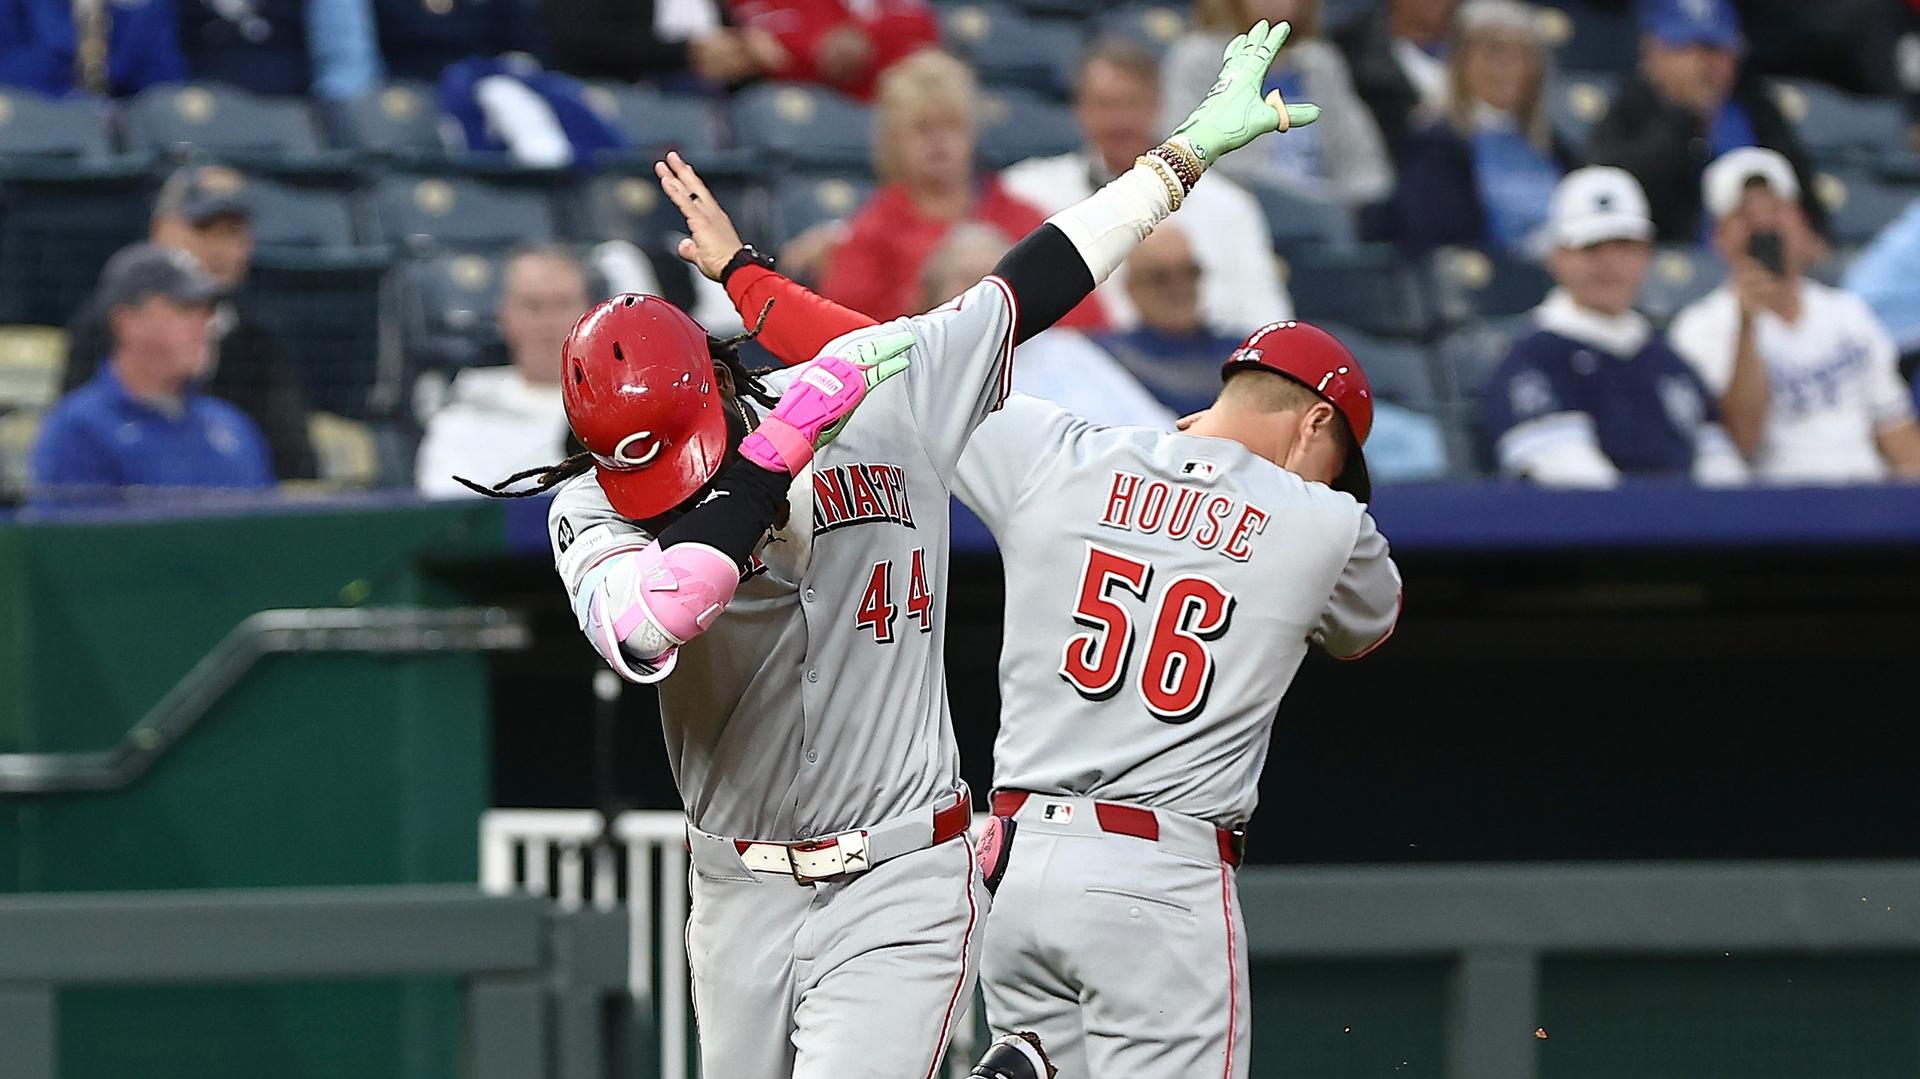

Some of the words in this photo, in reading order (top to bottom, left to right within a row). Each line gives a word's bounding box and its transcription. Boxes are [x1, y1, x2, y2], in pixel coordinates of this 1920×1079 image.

[614, 430, 661, 464] C
[813, 463, 917, 536] NATI
[1098, 469, 1271, 562] HOUSE
[855, 546, 934, 645] 44
[1058, 540, 1237, 724] 56
